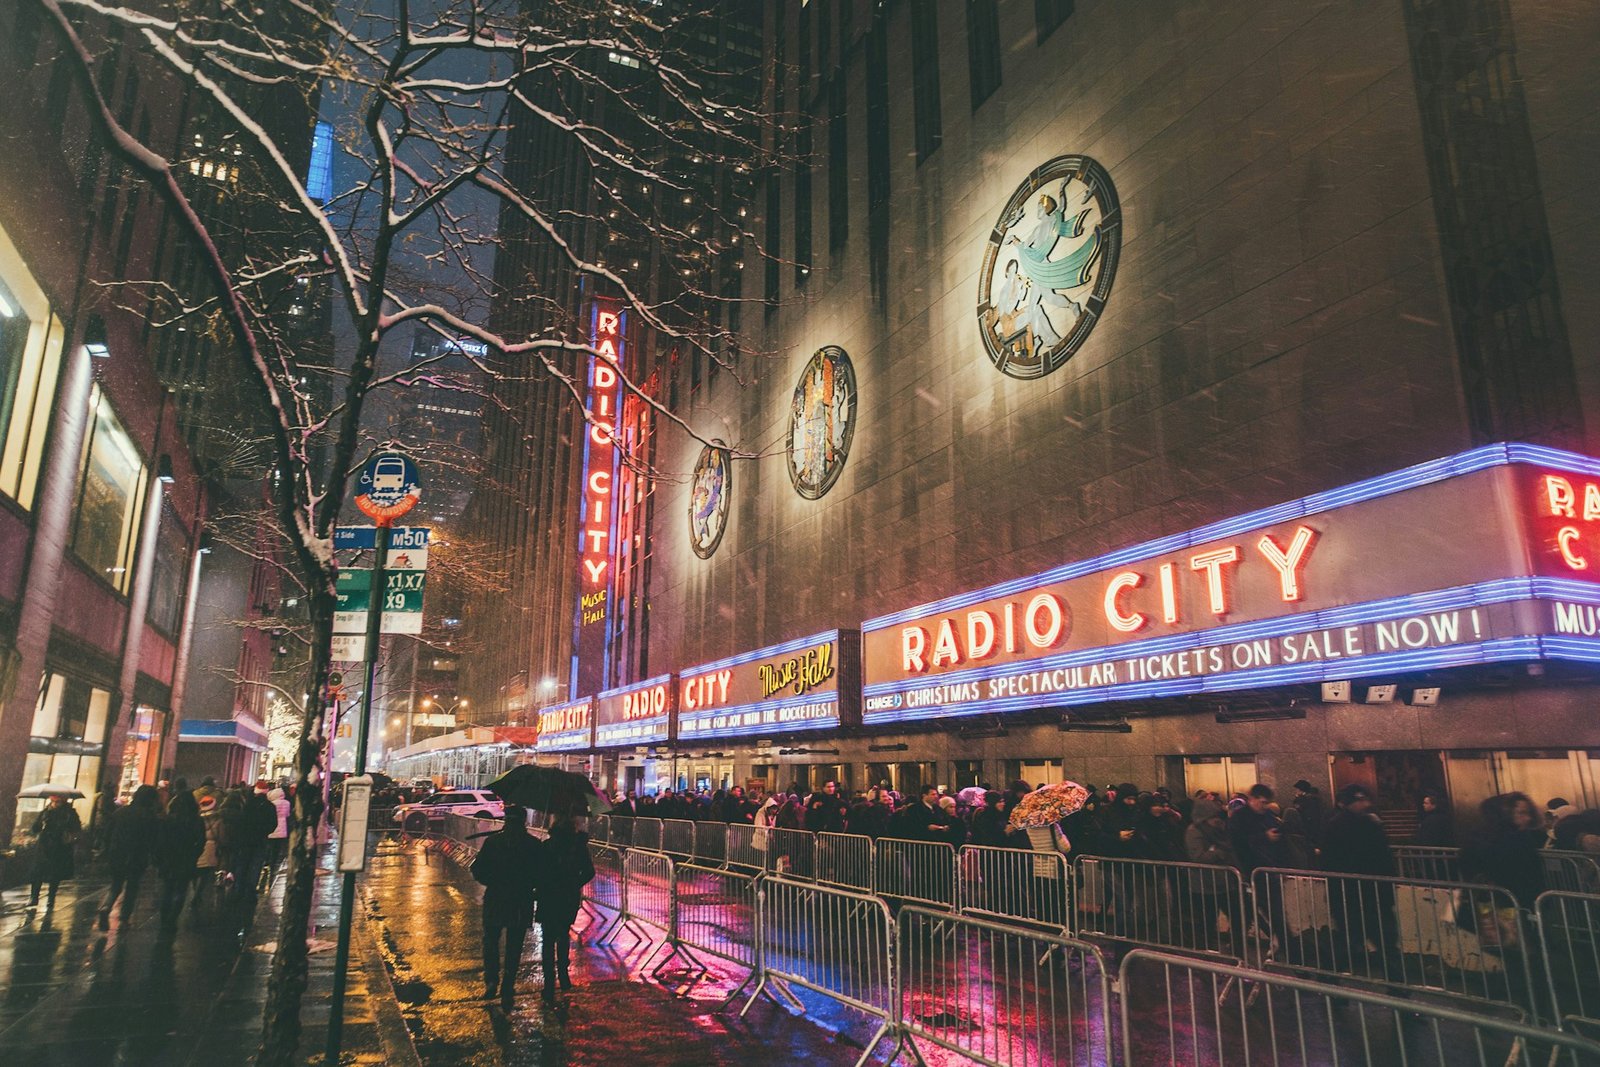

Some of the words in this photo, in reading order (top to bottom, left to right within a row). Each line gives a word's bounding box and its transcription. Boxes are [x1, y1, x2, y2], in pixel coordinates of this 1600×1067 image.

[591, 312, 619, 444] RADIO
[392, 530, 425, 547] M50
[585, 471, 610, 583] CITY
[902, 593, 1064, 672] RADIO
[1103, 525, 1315, 633] CITY
[1555, 601, 1600, 636] MU
[685, 669, 731, 708] CITY
[758, 659, 796, 698] Music
[794, 643, 832, 695] Hall
[866, 695, 894, 710] CHASE
[906, 680, 980, 708] CHRISTMAS
[988, 662, 1116, 699] SPECTACULAR
[1126, 646, 1223, 682] TICKETS
[1232, 640, 1272, 668] ON
[1283, 627, 1363, 663] SALE
[623, 685, 665, 720] RADIO
[712, 715, 726, 728] FOR
[727, 713, 742, 727] JOY
[744, 710, 761, 725] WITH
[763, 709, 776, 723] THE
[779, 702, 831, 721] ROCKETTES!
